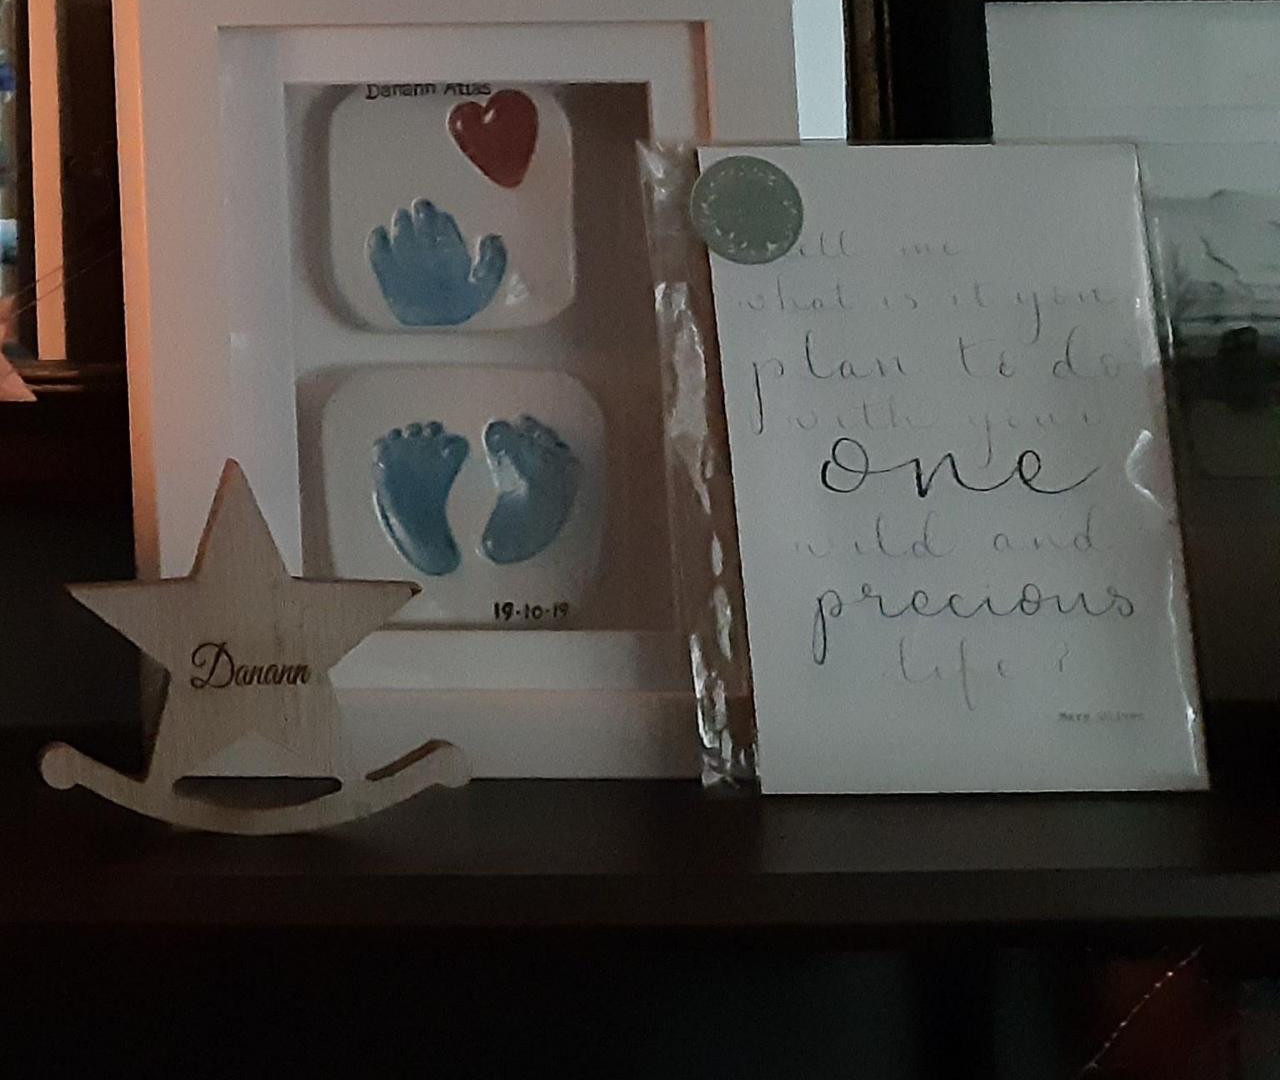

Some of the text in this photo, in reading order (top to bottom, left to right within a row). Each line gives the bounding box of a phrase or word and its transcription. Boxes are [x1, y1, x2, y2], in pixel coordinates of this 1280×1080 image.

[751, 330, 908, 436] plan
[959, 335, 1017, 380] to
[821, 436, 1101, 498] one
[992, 506, 1107, 554] and
[812, 582, 1137, 666] precious
[190, 641, 311, 690] Danann
